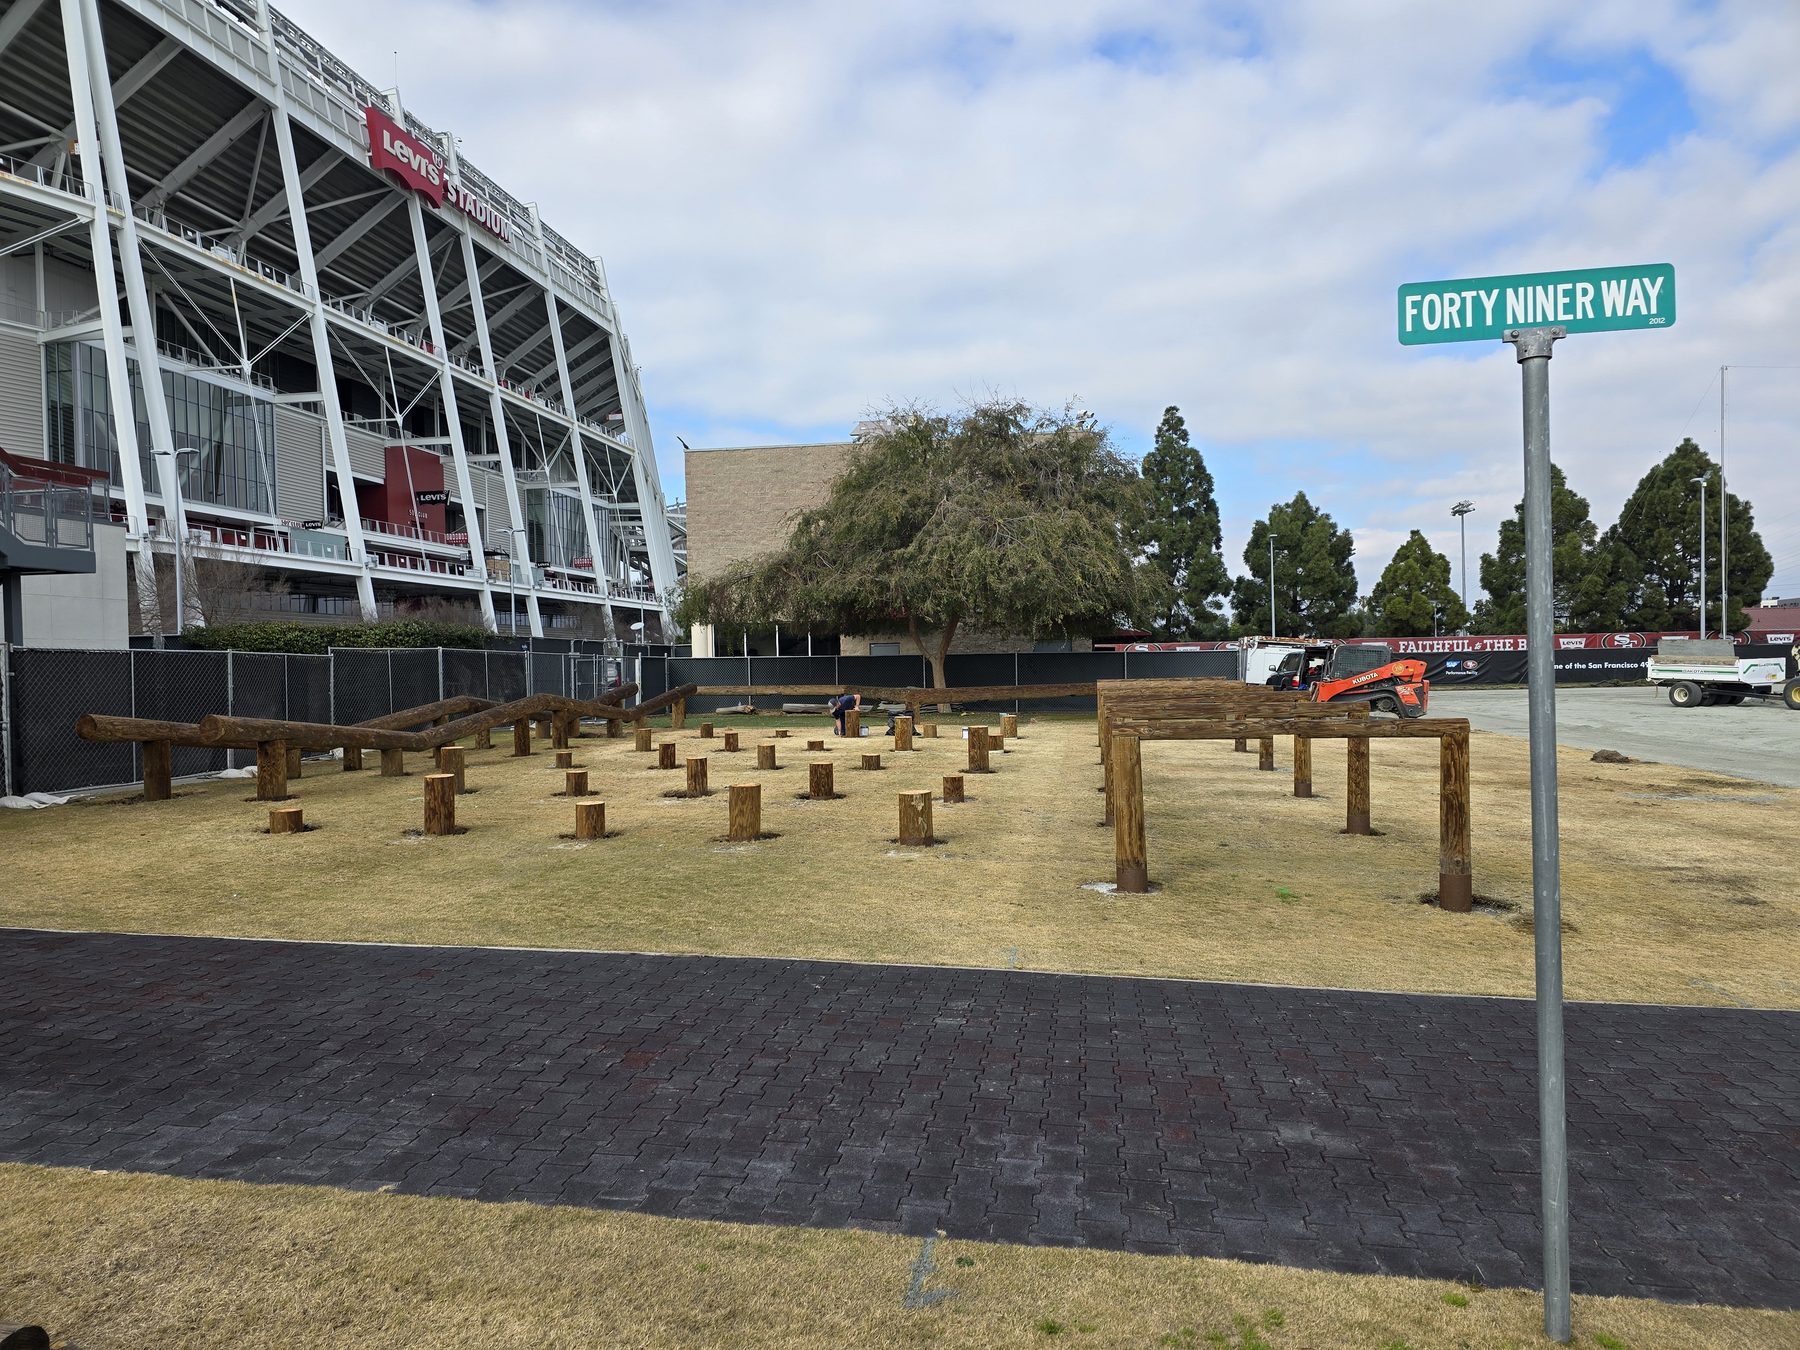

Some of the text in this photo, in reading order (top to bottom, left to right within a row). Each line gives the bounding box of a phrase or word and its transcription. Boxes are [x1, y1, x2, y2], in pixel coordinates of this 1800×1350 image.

[447, 183, 513, 242] STADIUM
[1405, 276, 1665, 332] FORTY NINER WAY
[1648, 316, 1666, 325] 2012
[1398, 640, 1472, 653] FAITHFUL
[1484, 639, 1513, 651] THE
[1604, 661, 1638, 669] Francisco
[1352, 672, 1379, 685] KUBOTA
